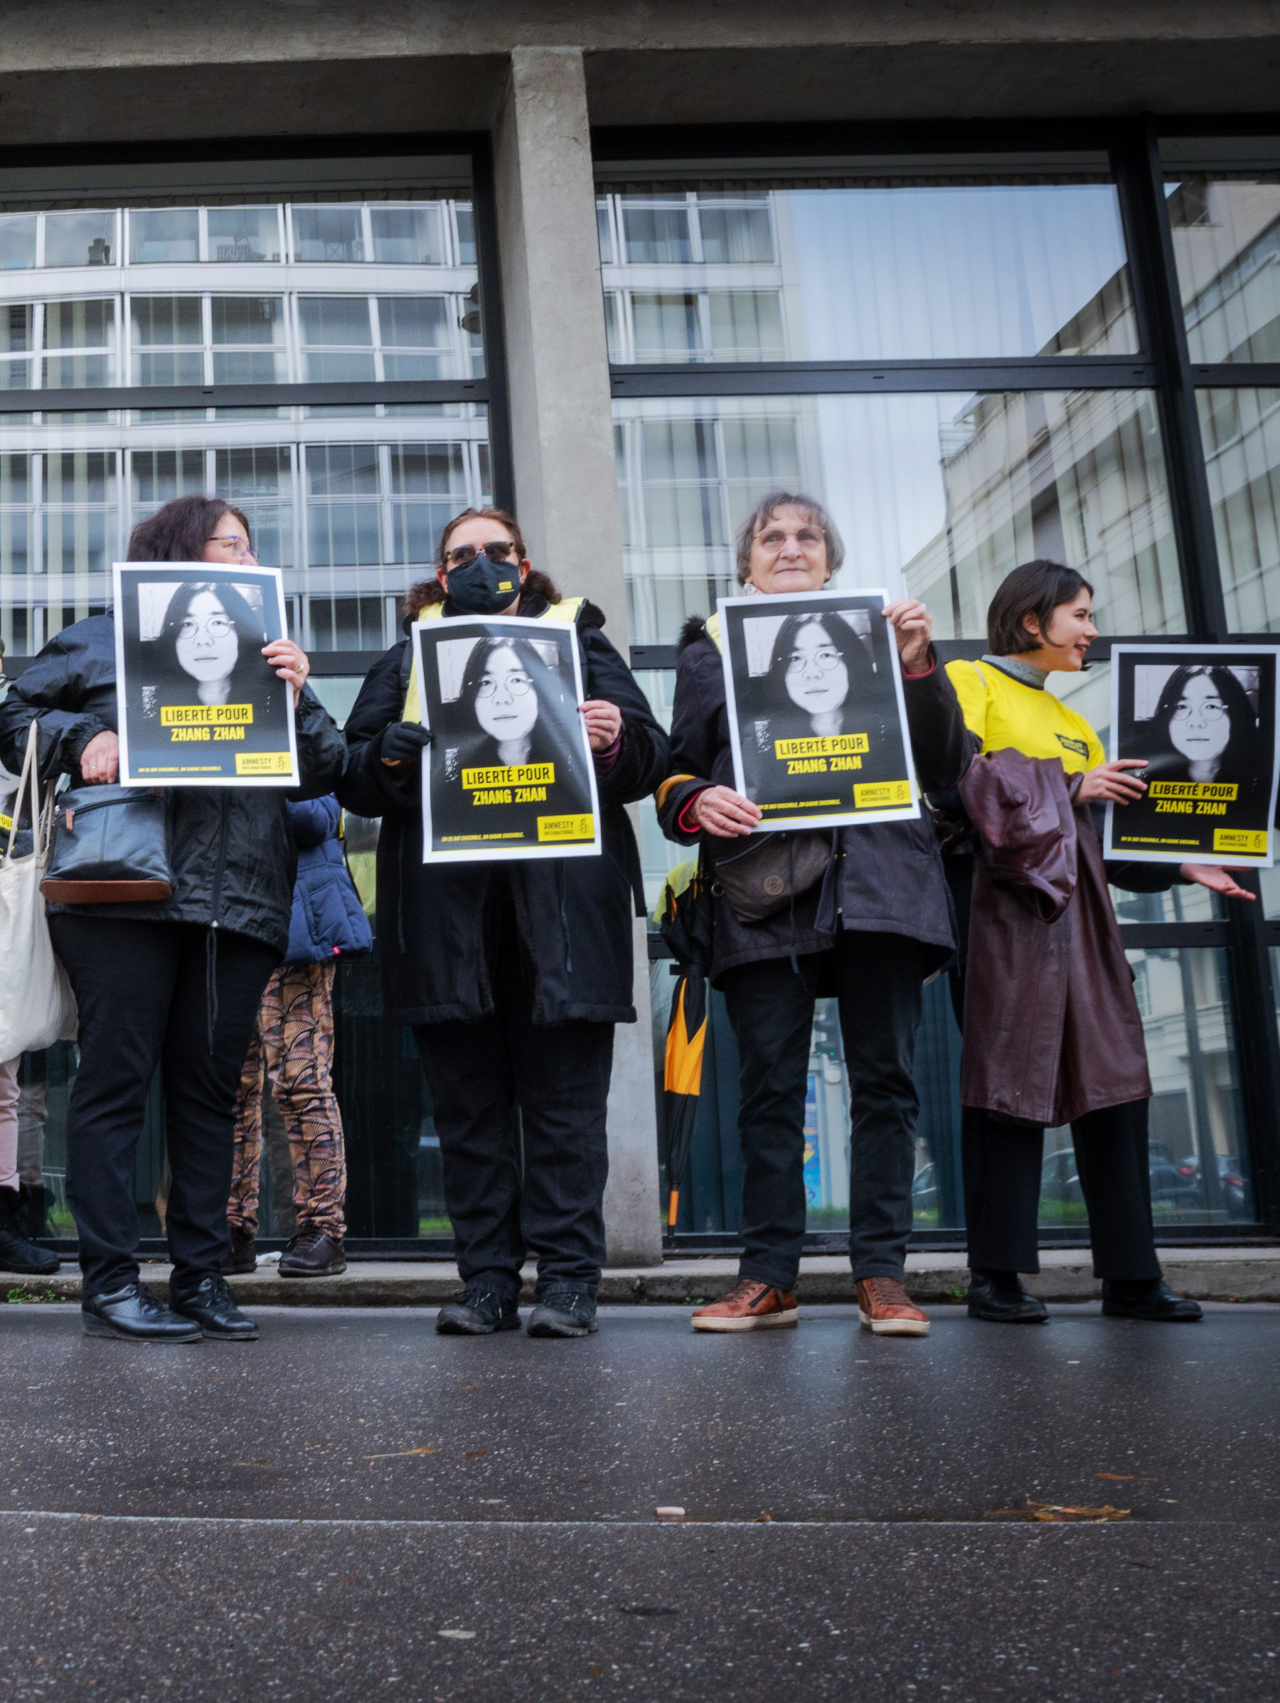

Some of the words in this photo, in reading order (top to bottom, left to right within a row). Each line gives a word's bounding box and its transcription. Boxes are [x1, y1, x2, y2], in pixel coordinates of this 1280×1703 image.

[165, 706, 213, 722] LIBERTÉ
[217, 707, 249, 721] POUR
[171, 727, 211, 742] ZHANG
[213, 726, 245, 740] ZHAN
[780, 737, 827, 755] LIBERTÉ
[832, 736, 864, 751] POUR
[787, 759, 827, 775] ZHANG
[829, 756, 862, 771] ZHAN
[466, 767, 513, 785] LIBERTÉ
[518, 766, 550, 781] POUR
[472, 790, 512, 806] ZHANG
[515, 786, 547, 803] ZHAN
[860, 788, 891, 796] AMNESTY
[1153, 783, 1199, 796] LIBERTÉ
[1202, 785, 1234, 797] POUR
[1155, 800, 1193, 814] ZHANG
[1195, 801, 1227, 815] ZHAN
[544, 821, 574, 829] AMNESTY
[1220, 834, 1248, 842] AMNESTY
